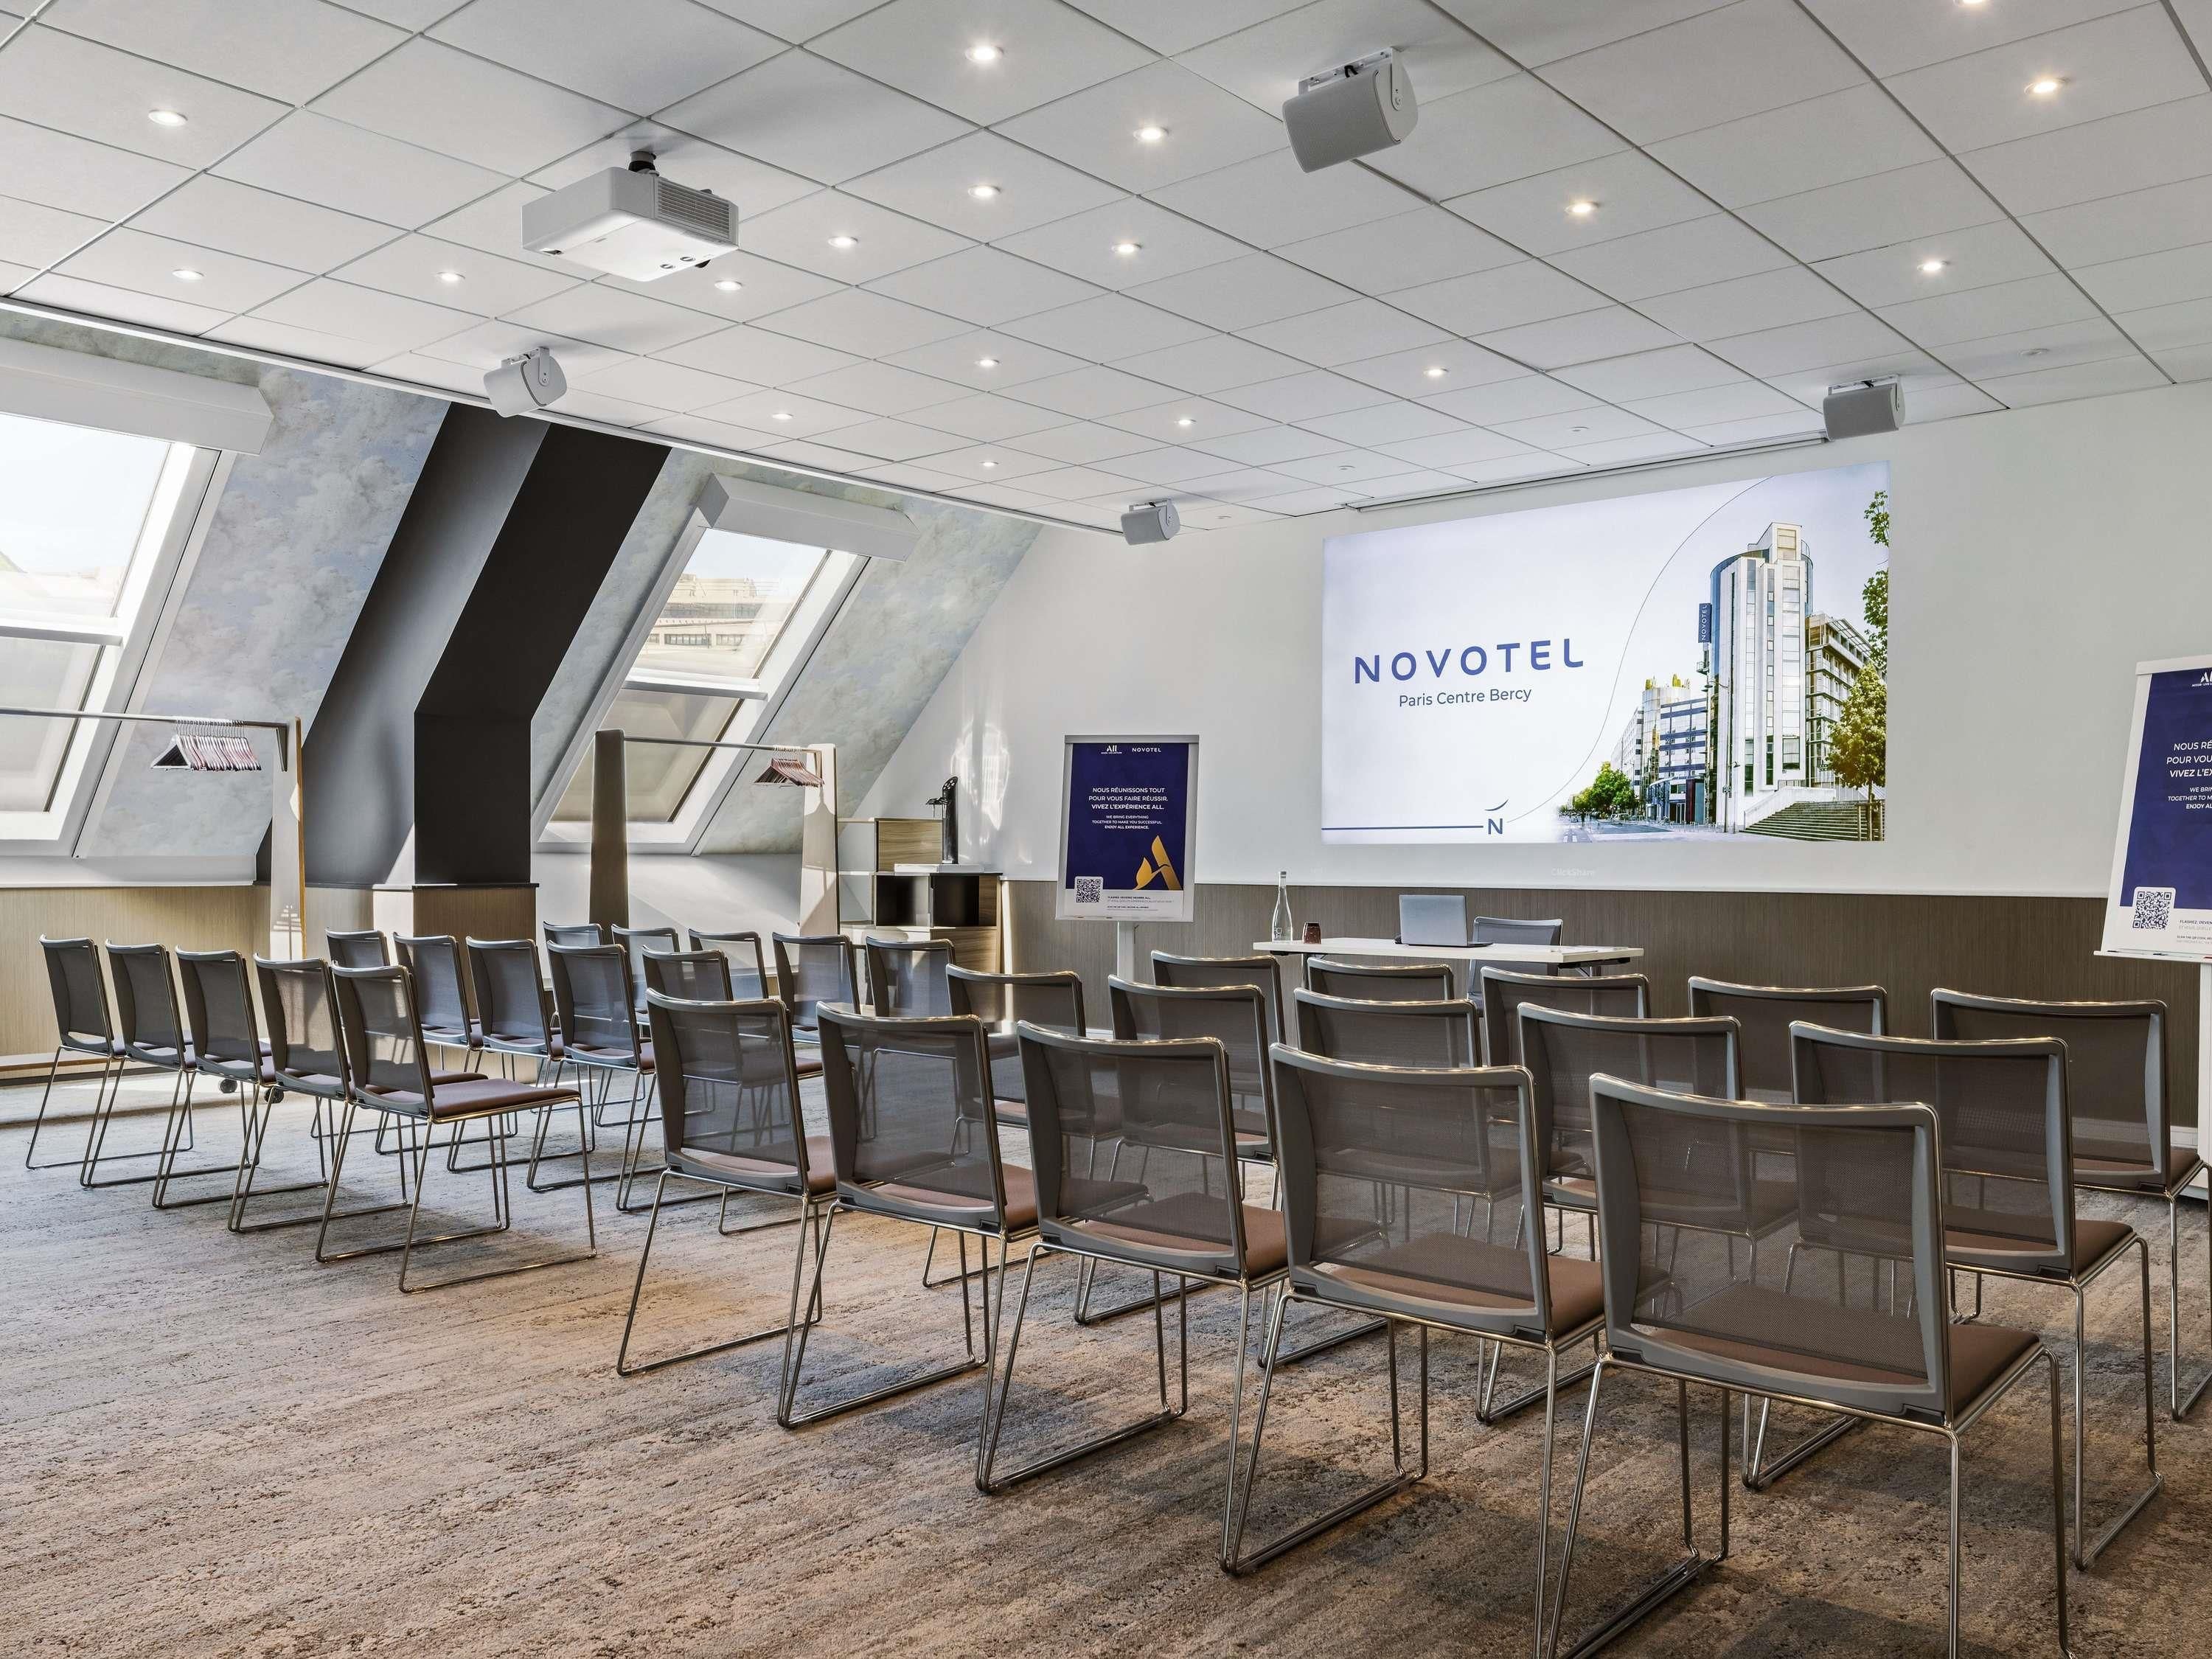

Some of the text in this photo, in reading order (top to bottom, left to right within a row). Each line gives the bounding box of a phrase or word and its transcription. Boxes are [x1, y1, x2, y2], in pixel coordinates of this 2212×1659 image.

[1354, 638, 1584, 684] NOVOTEL
[1399, 687, 1532, 707] Paris Centre Bercy
[2174, 742, 2199, 751] NOUS
[2166, 756, 2192, 765] POUR
[2170, 769, 2196, 778] VIVEZ
[1488, 818, 1503, 835] N
